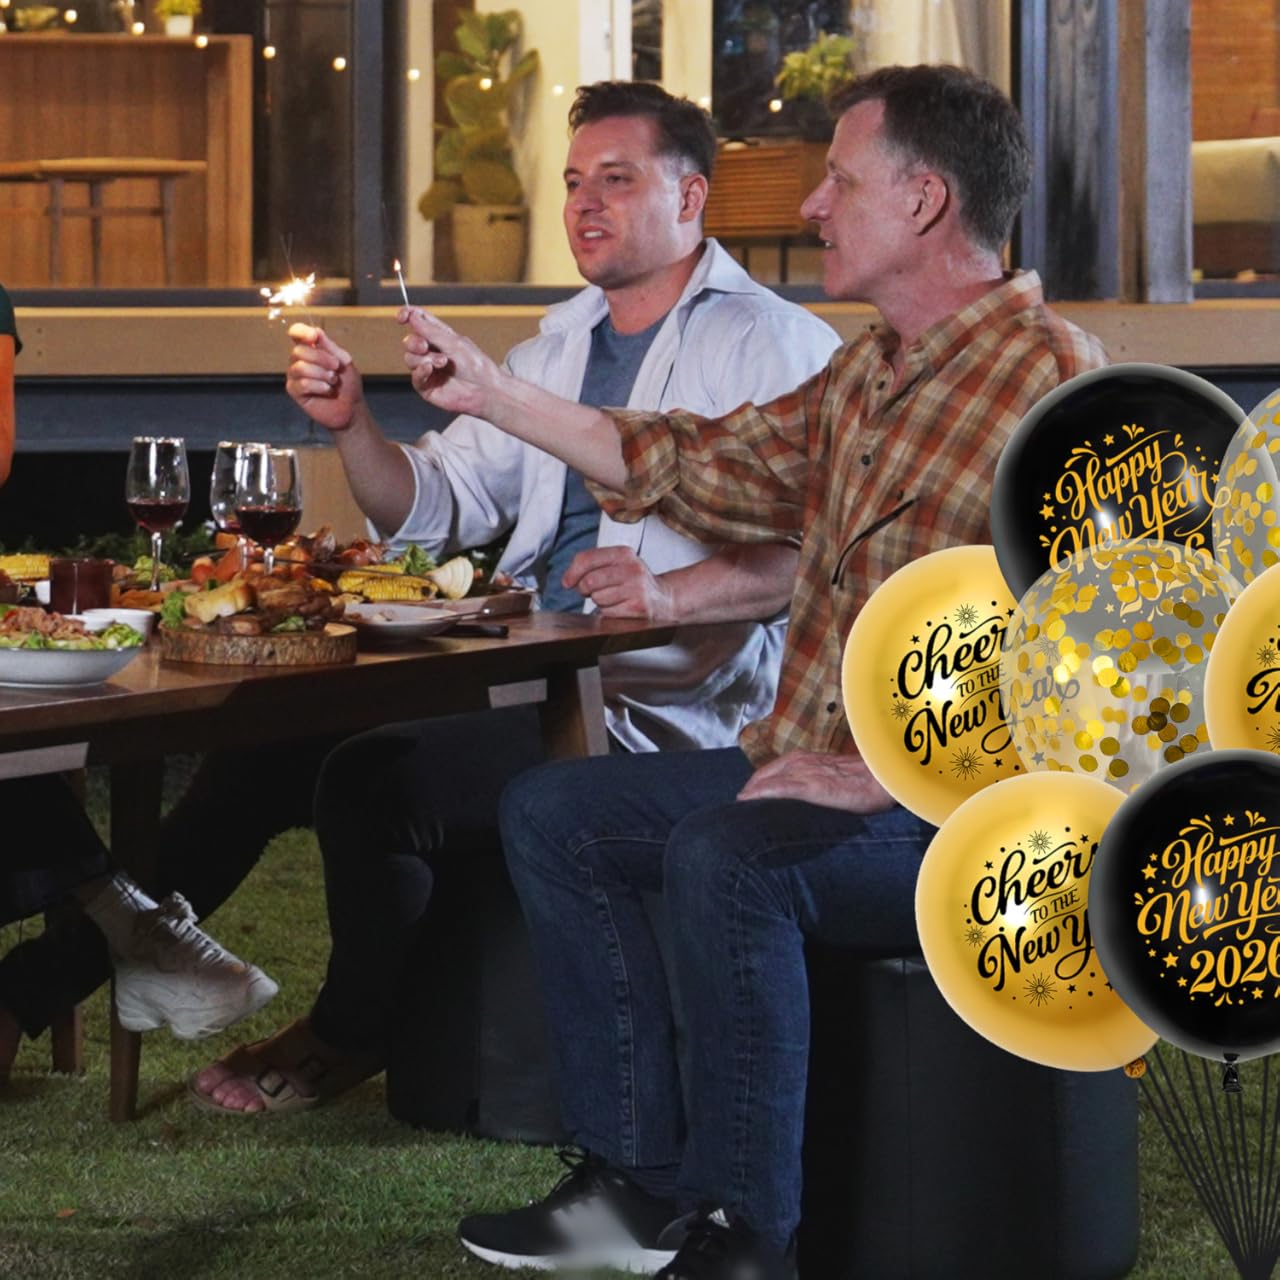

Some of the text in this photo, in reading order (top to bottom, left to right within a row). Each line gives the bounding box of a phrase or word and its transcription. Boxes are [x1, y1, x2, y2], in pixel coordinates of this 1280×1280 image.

[1055, 431, 1188, 521] Happy
[1049, 511, 1134, 575] New
[1129, 464, 1232, 549] Year
[898, 616, 1026, 700] Cheer
[956, 680, 976, 698] TO
[903, 700, 988, 766] New
[971, 841, 1099, 926] Cheer
[1161, 827, 1280, 888] Happy
[1029, 887, 1081, 924] TO THE
[1136, 877, 1280, 944] New Ye
[977, 926, 1061, 992] New
